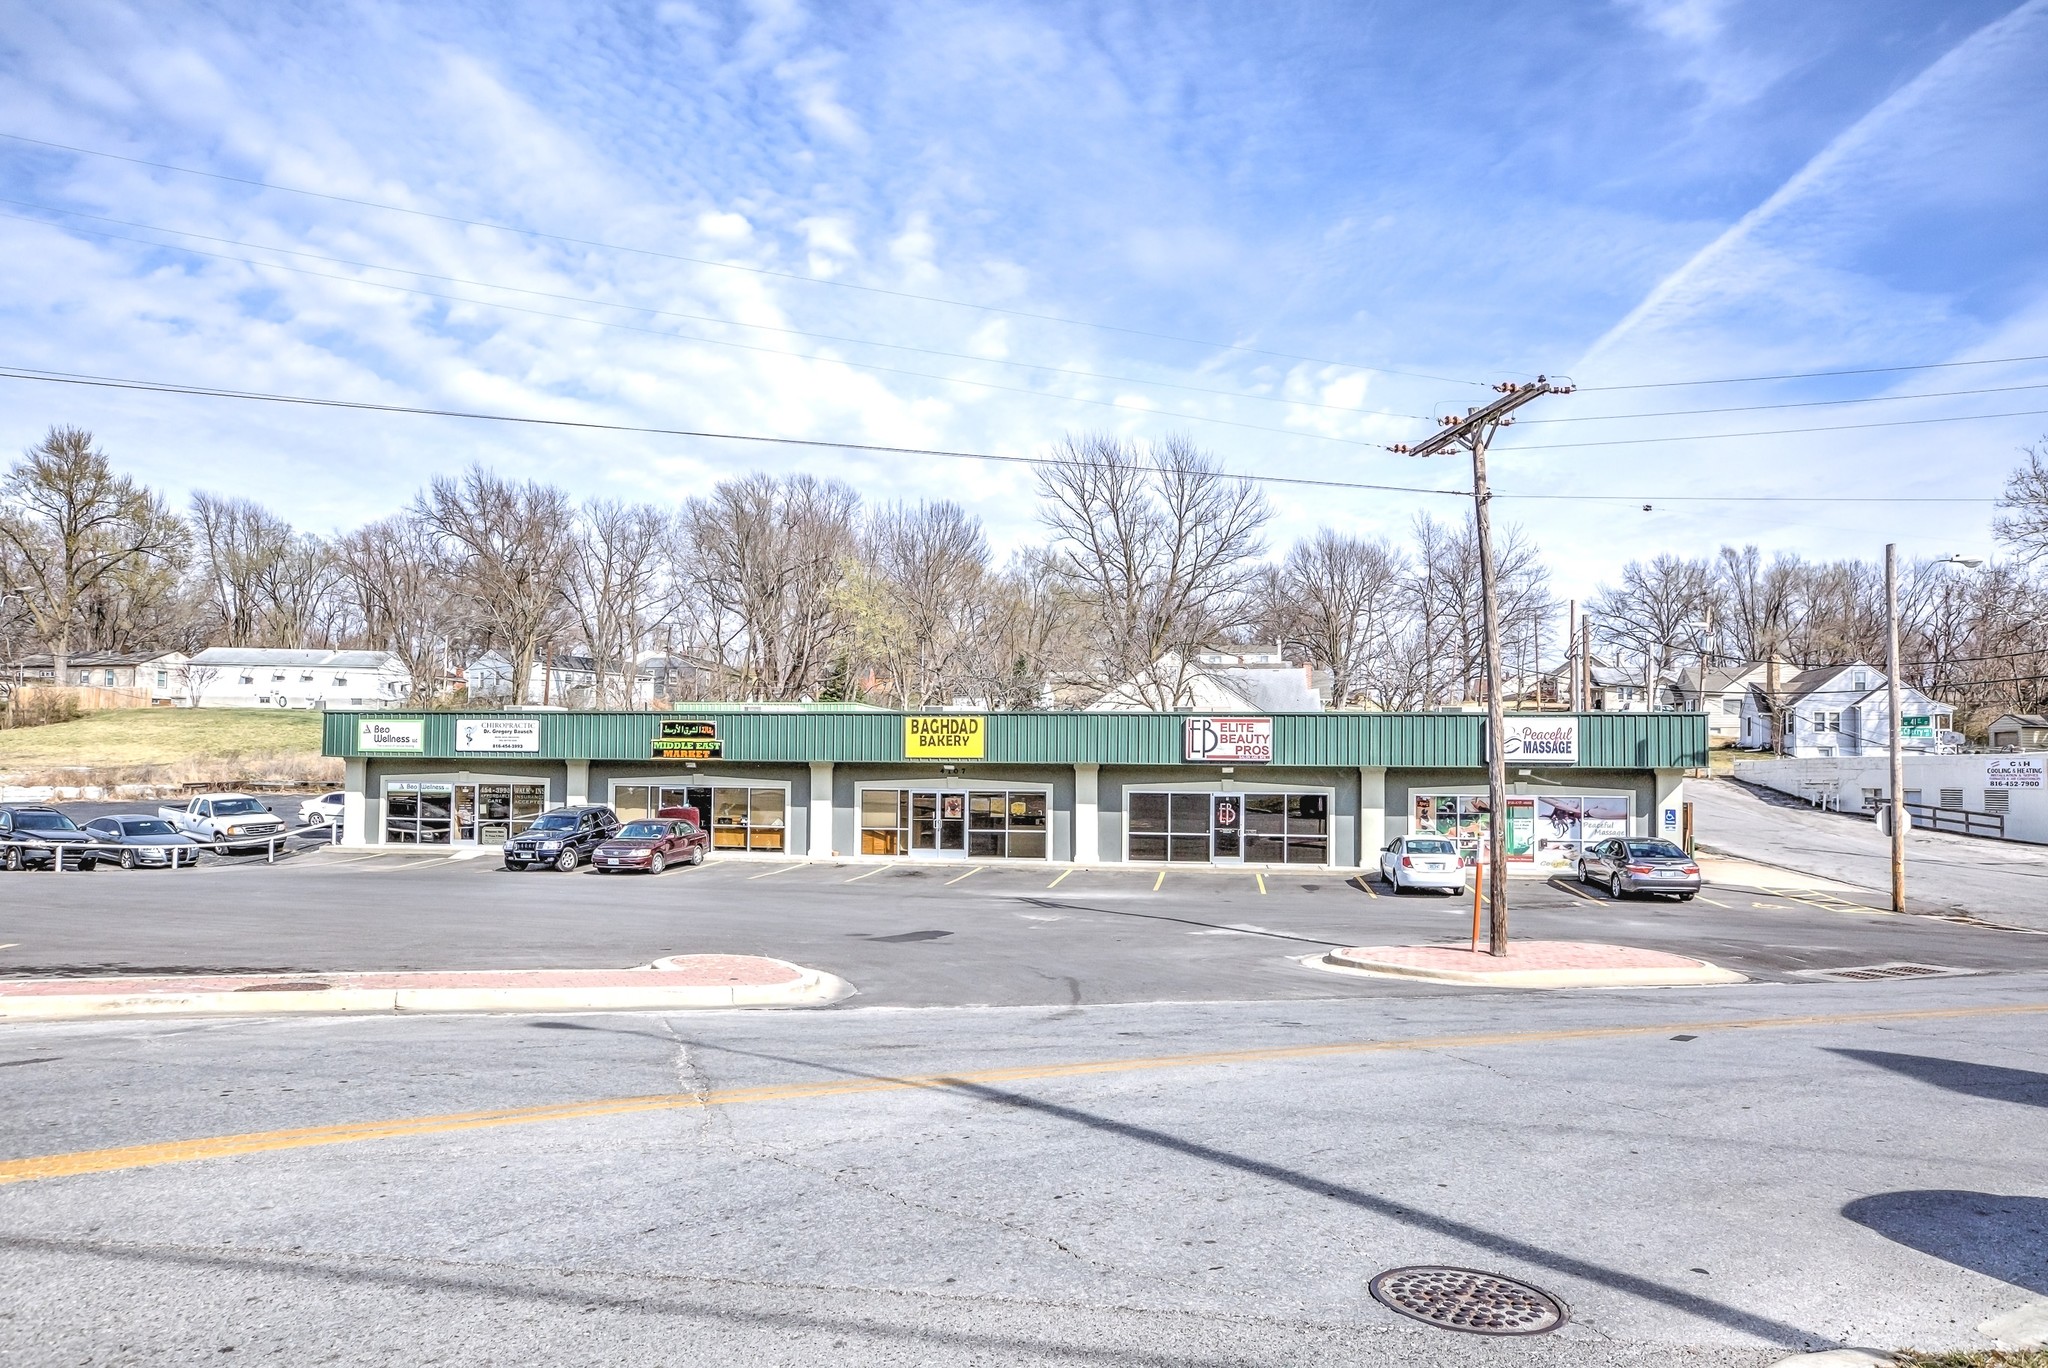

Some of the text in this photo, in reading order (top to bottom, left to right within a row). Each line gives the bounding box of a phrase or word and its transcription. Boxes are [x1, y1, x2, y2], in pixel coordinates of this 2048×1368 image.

[374, 724, 390, 734] Beo
[911, 718, 979, 735] BAGHDAD
[1220, 722, 1254, 733] ELITE
[373, 734, 410, 743] Wellness
[1220, 734, 1270, 744] BEAUTY
[1522, 726, 1573, 744] Peaceful
[653, 742, 721, 750] MIDDLE EAST
[919, 735, 970, 747] BAKERY
[1235, 745, 1270, 756] PROS
[1523, 741, 1572, 754] MASSAGE
[663, 750, 710, 758] MARKET
[1594, 828, 1625, 836] Massage
